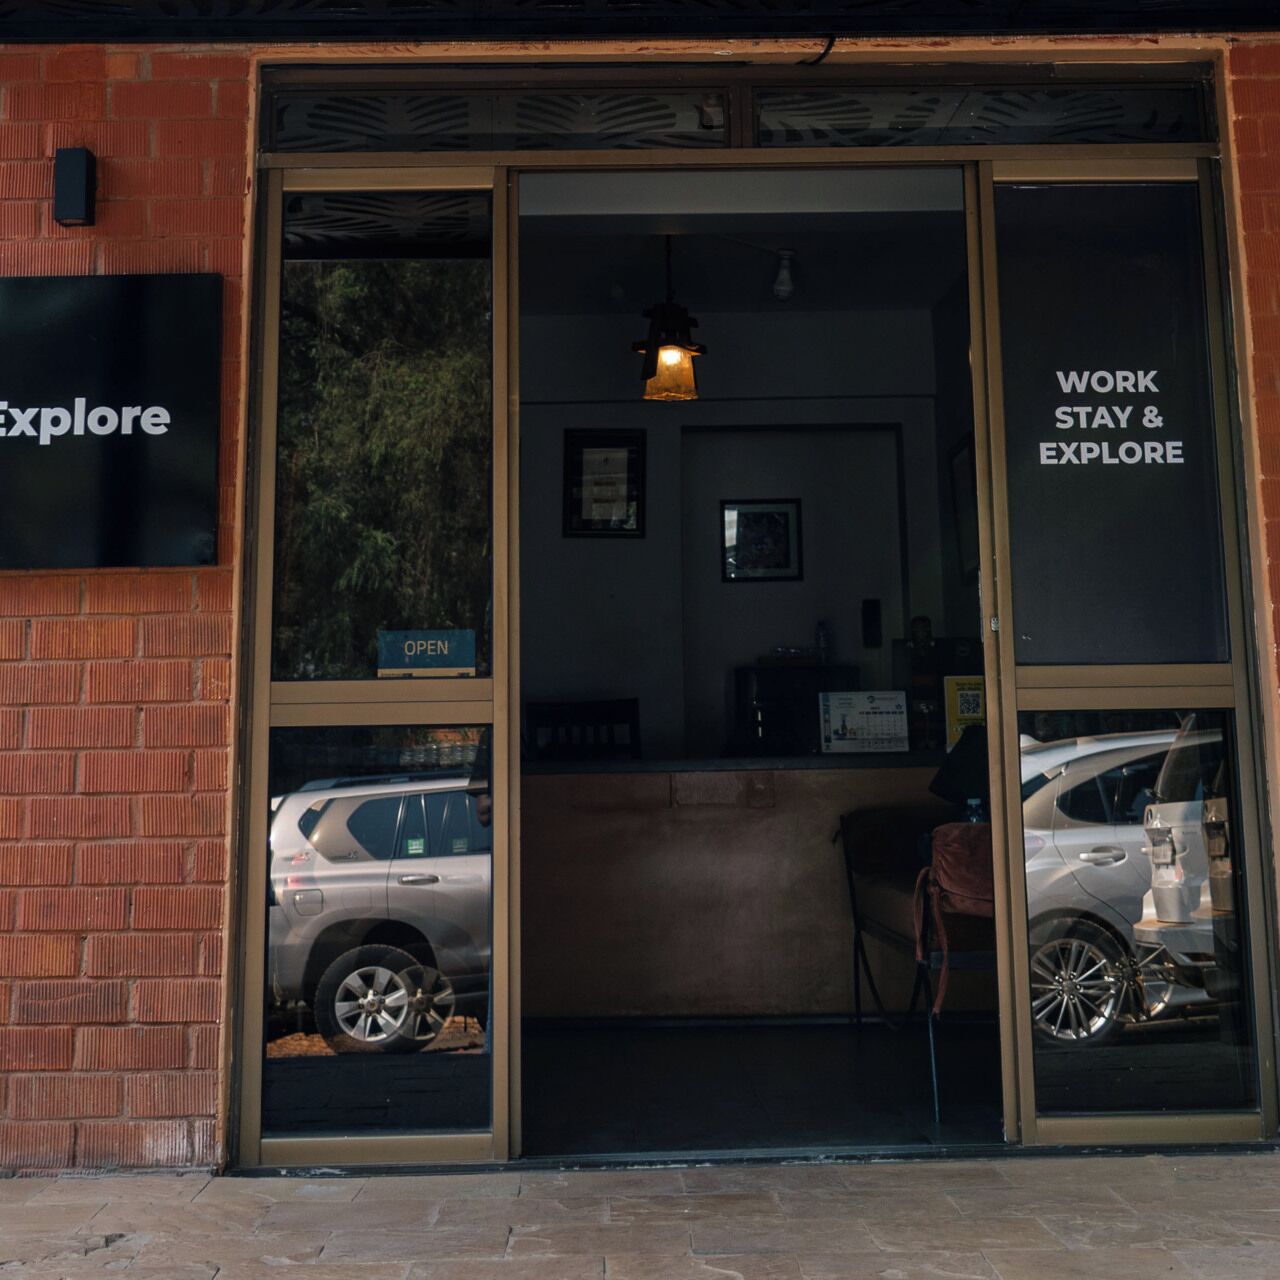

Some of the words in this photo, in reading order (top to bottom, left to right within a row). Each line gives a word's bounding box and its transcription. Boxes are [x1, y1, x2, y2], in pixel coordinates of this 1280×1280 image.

[1056, 370, 1159, 394] WORK
[1054, 405, 1133, 430] STAY
[1141, 405, 1164, 429] &
[1039, 441, 1185, 465] EXPLORE
[404, 640, 449, 656] OPEN
